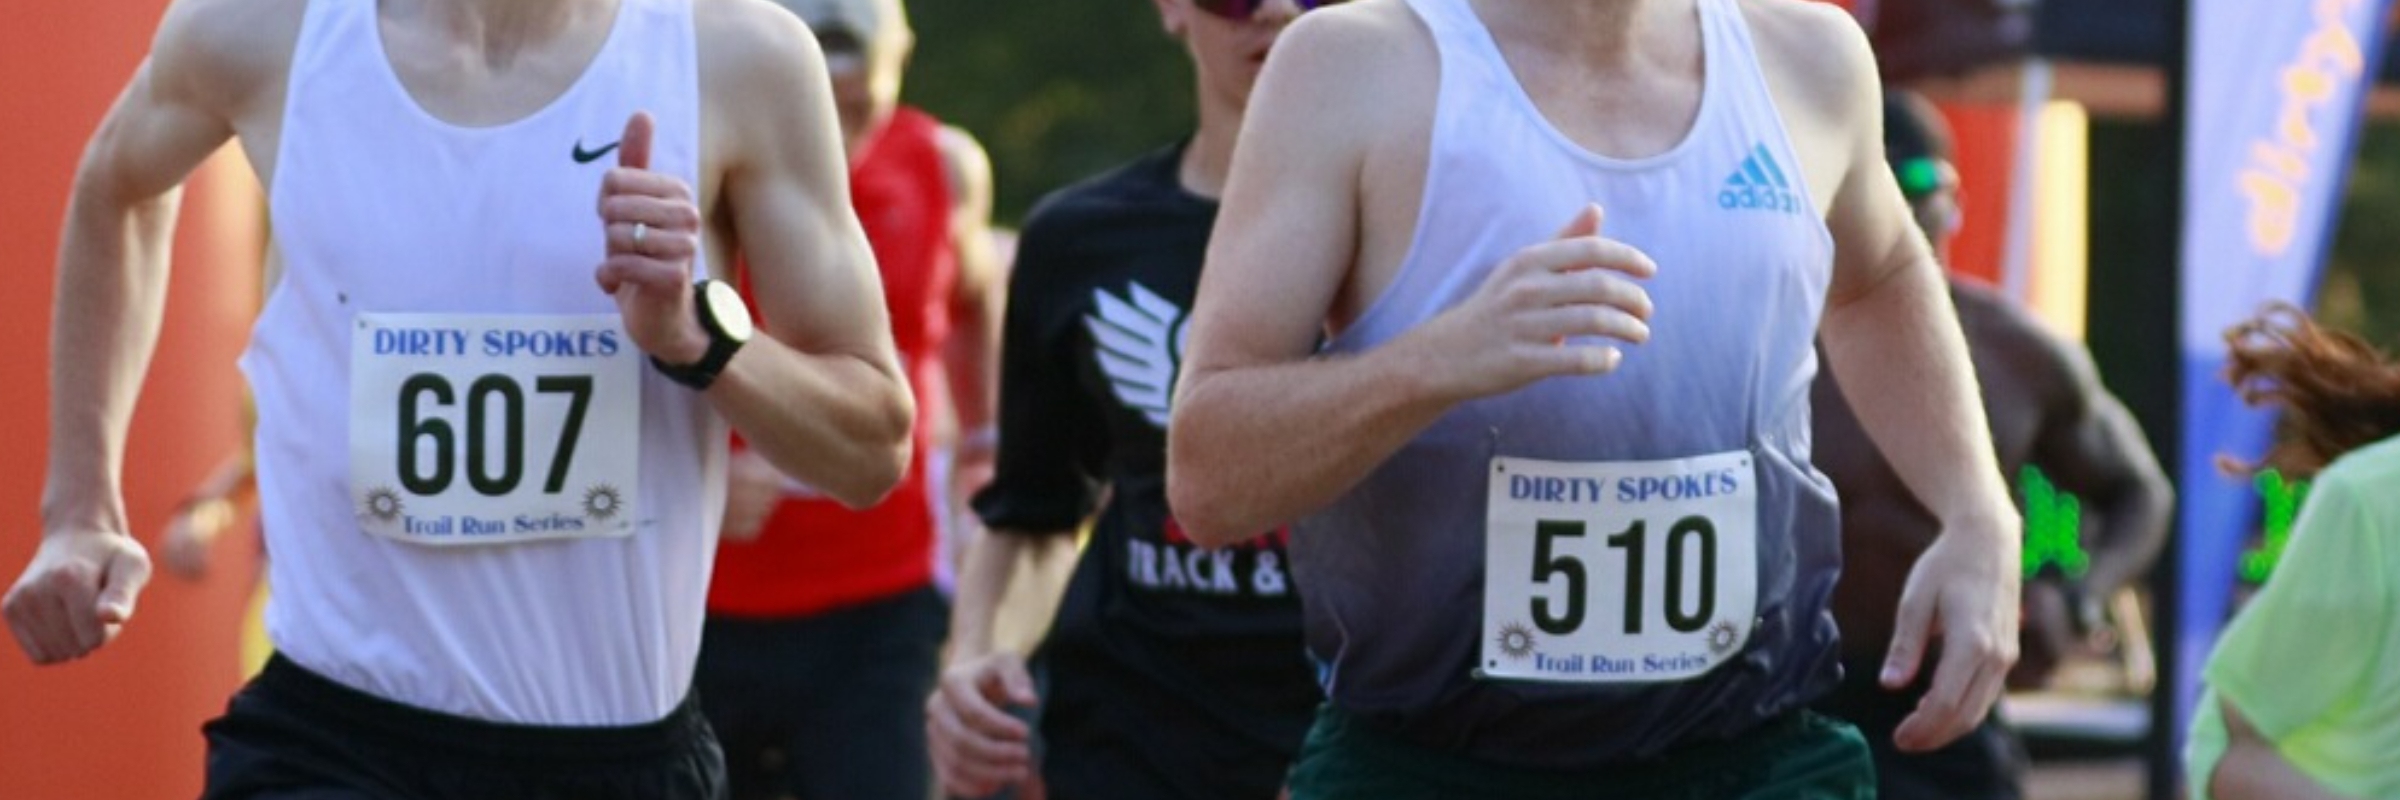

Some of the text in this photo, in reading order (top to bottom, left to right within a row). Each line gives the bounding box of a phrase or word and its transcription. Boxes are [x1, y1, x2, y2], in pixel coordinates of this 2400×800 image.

[373, 328, 619, 357] DIRTY SPOKES
[396, 372, 594, 498] 607
[1509, 468, 1738, 503] DIRTY SPOKES
[403, 513, 584, 536] Trail Run Series
[1252, 550, 1287, 595] &
[1529, 514, 1718, 637] 510
[1534, 652, 1708, 675] Trail Run Series
